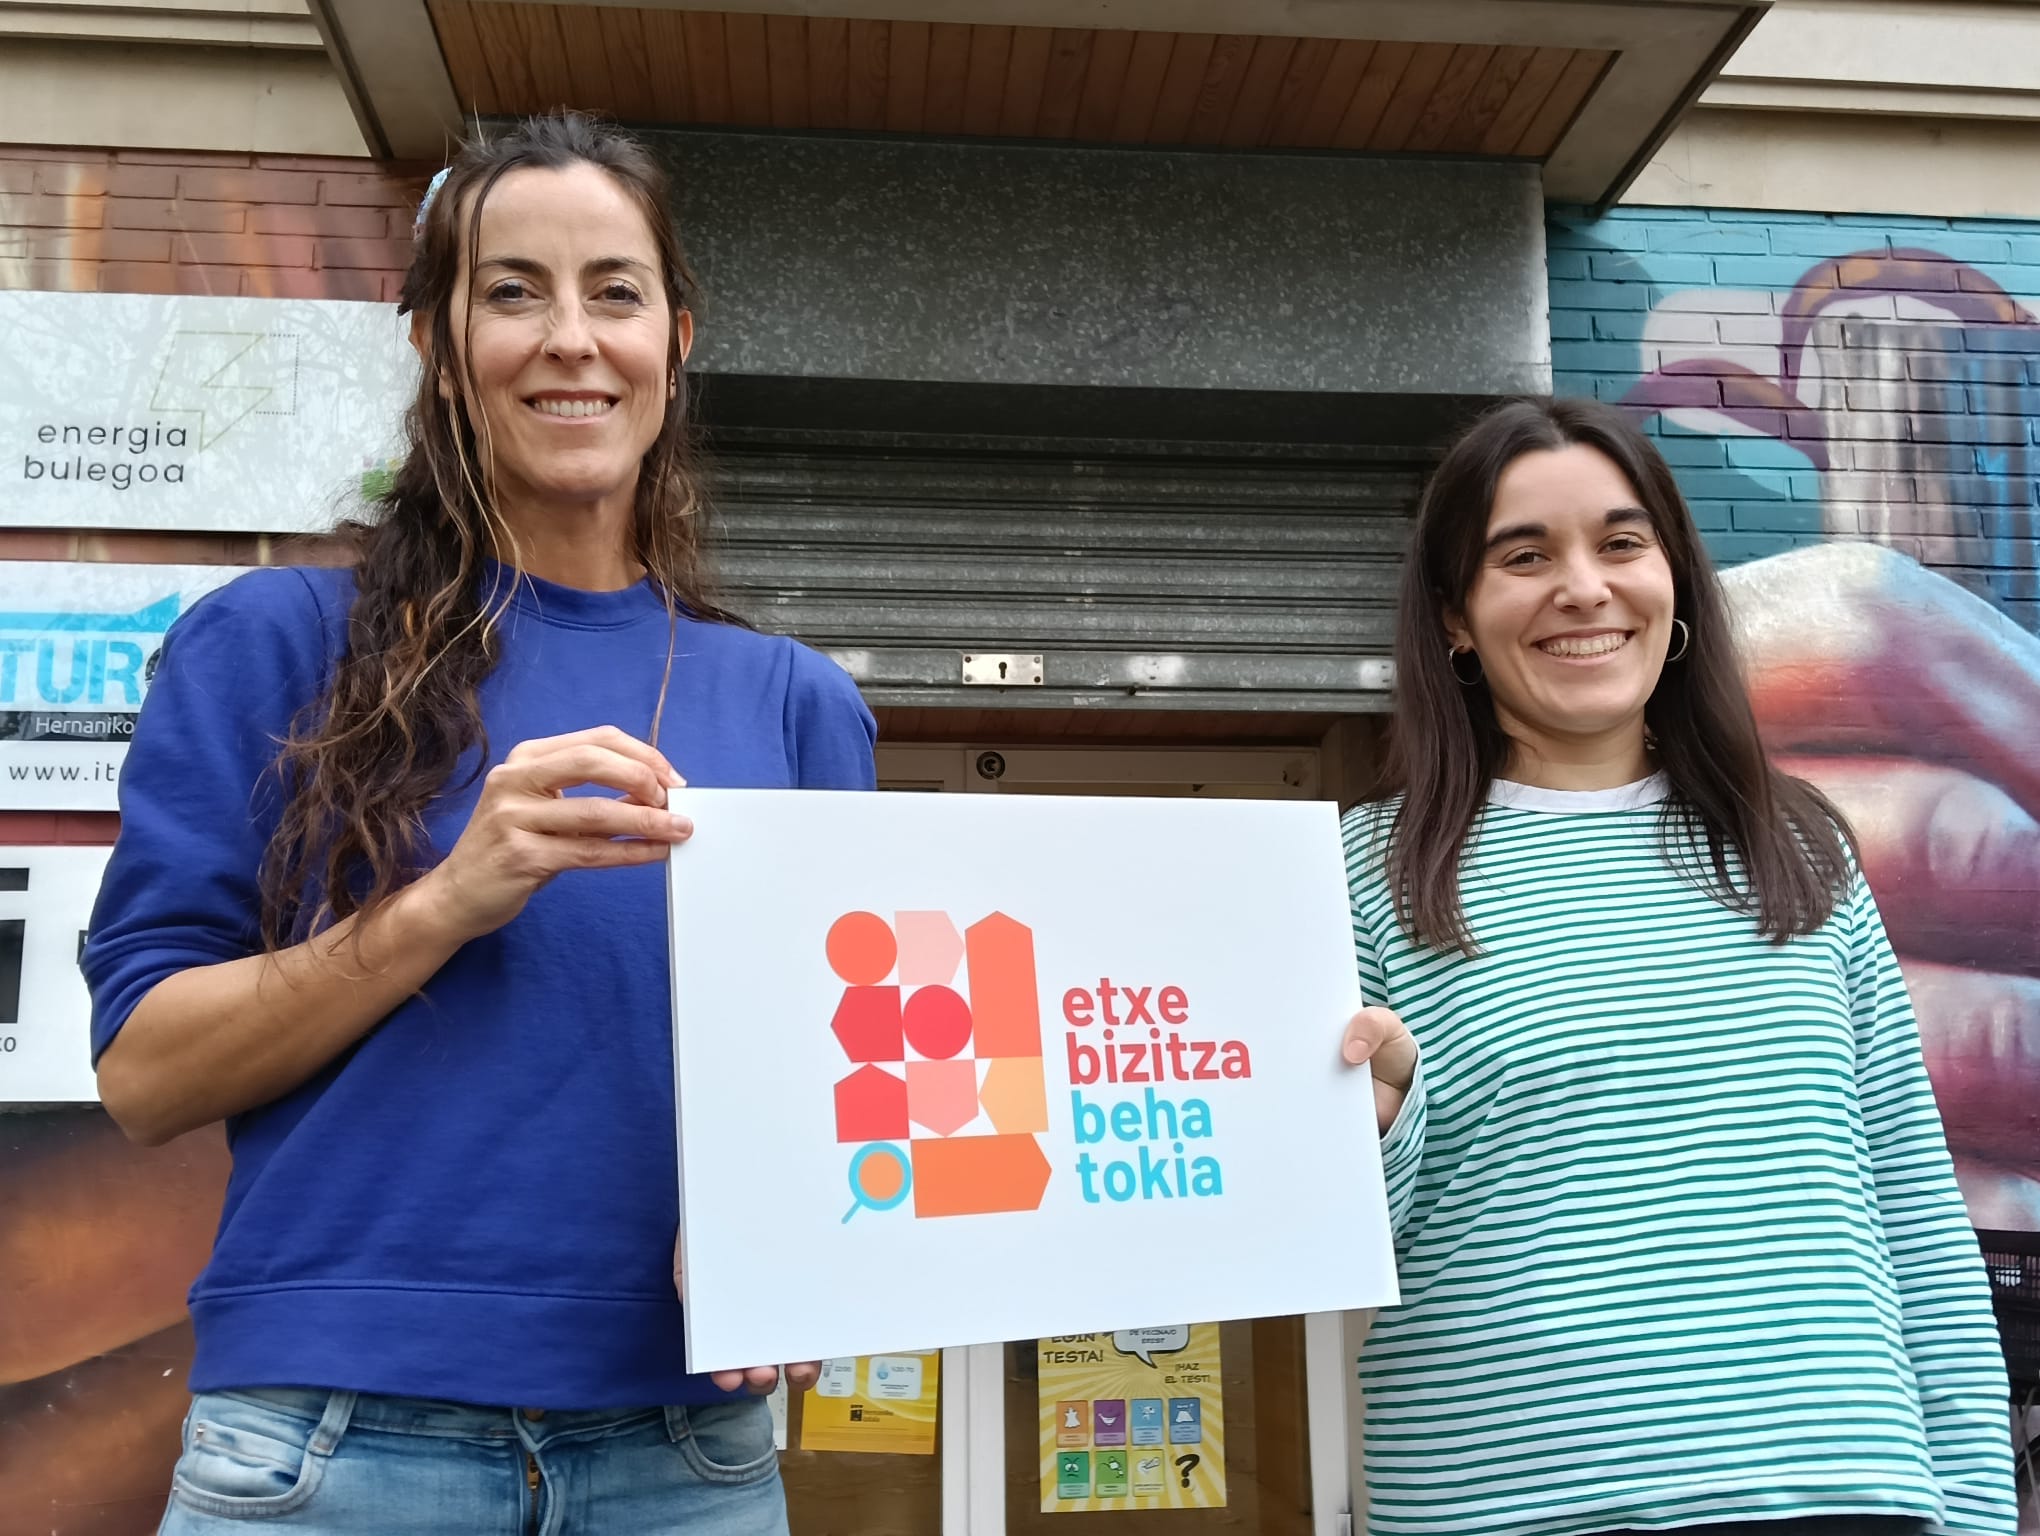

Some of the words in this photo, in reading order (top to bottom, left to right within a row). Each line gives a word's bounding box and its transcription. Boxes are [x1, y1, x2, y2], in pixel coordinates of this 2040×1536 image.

[37, 420, 187, 454] energia
[24, 454, 185, 491] bulegoa
[35, 716, 135, 735] Hernaniko
[1062, 977, 1189, 1027] etxe
[1065, 1027, 1252, 1085] bizitza
[1071, 1087, 1213, 1144] beha
[1075, 1142, 1223, 1204] tokia
[1043, 1350, 1104, 1363] TESTA!
[1164, 1375, 1177, 1384] EL
